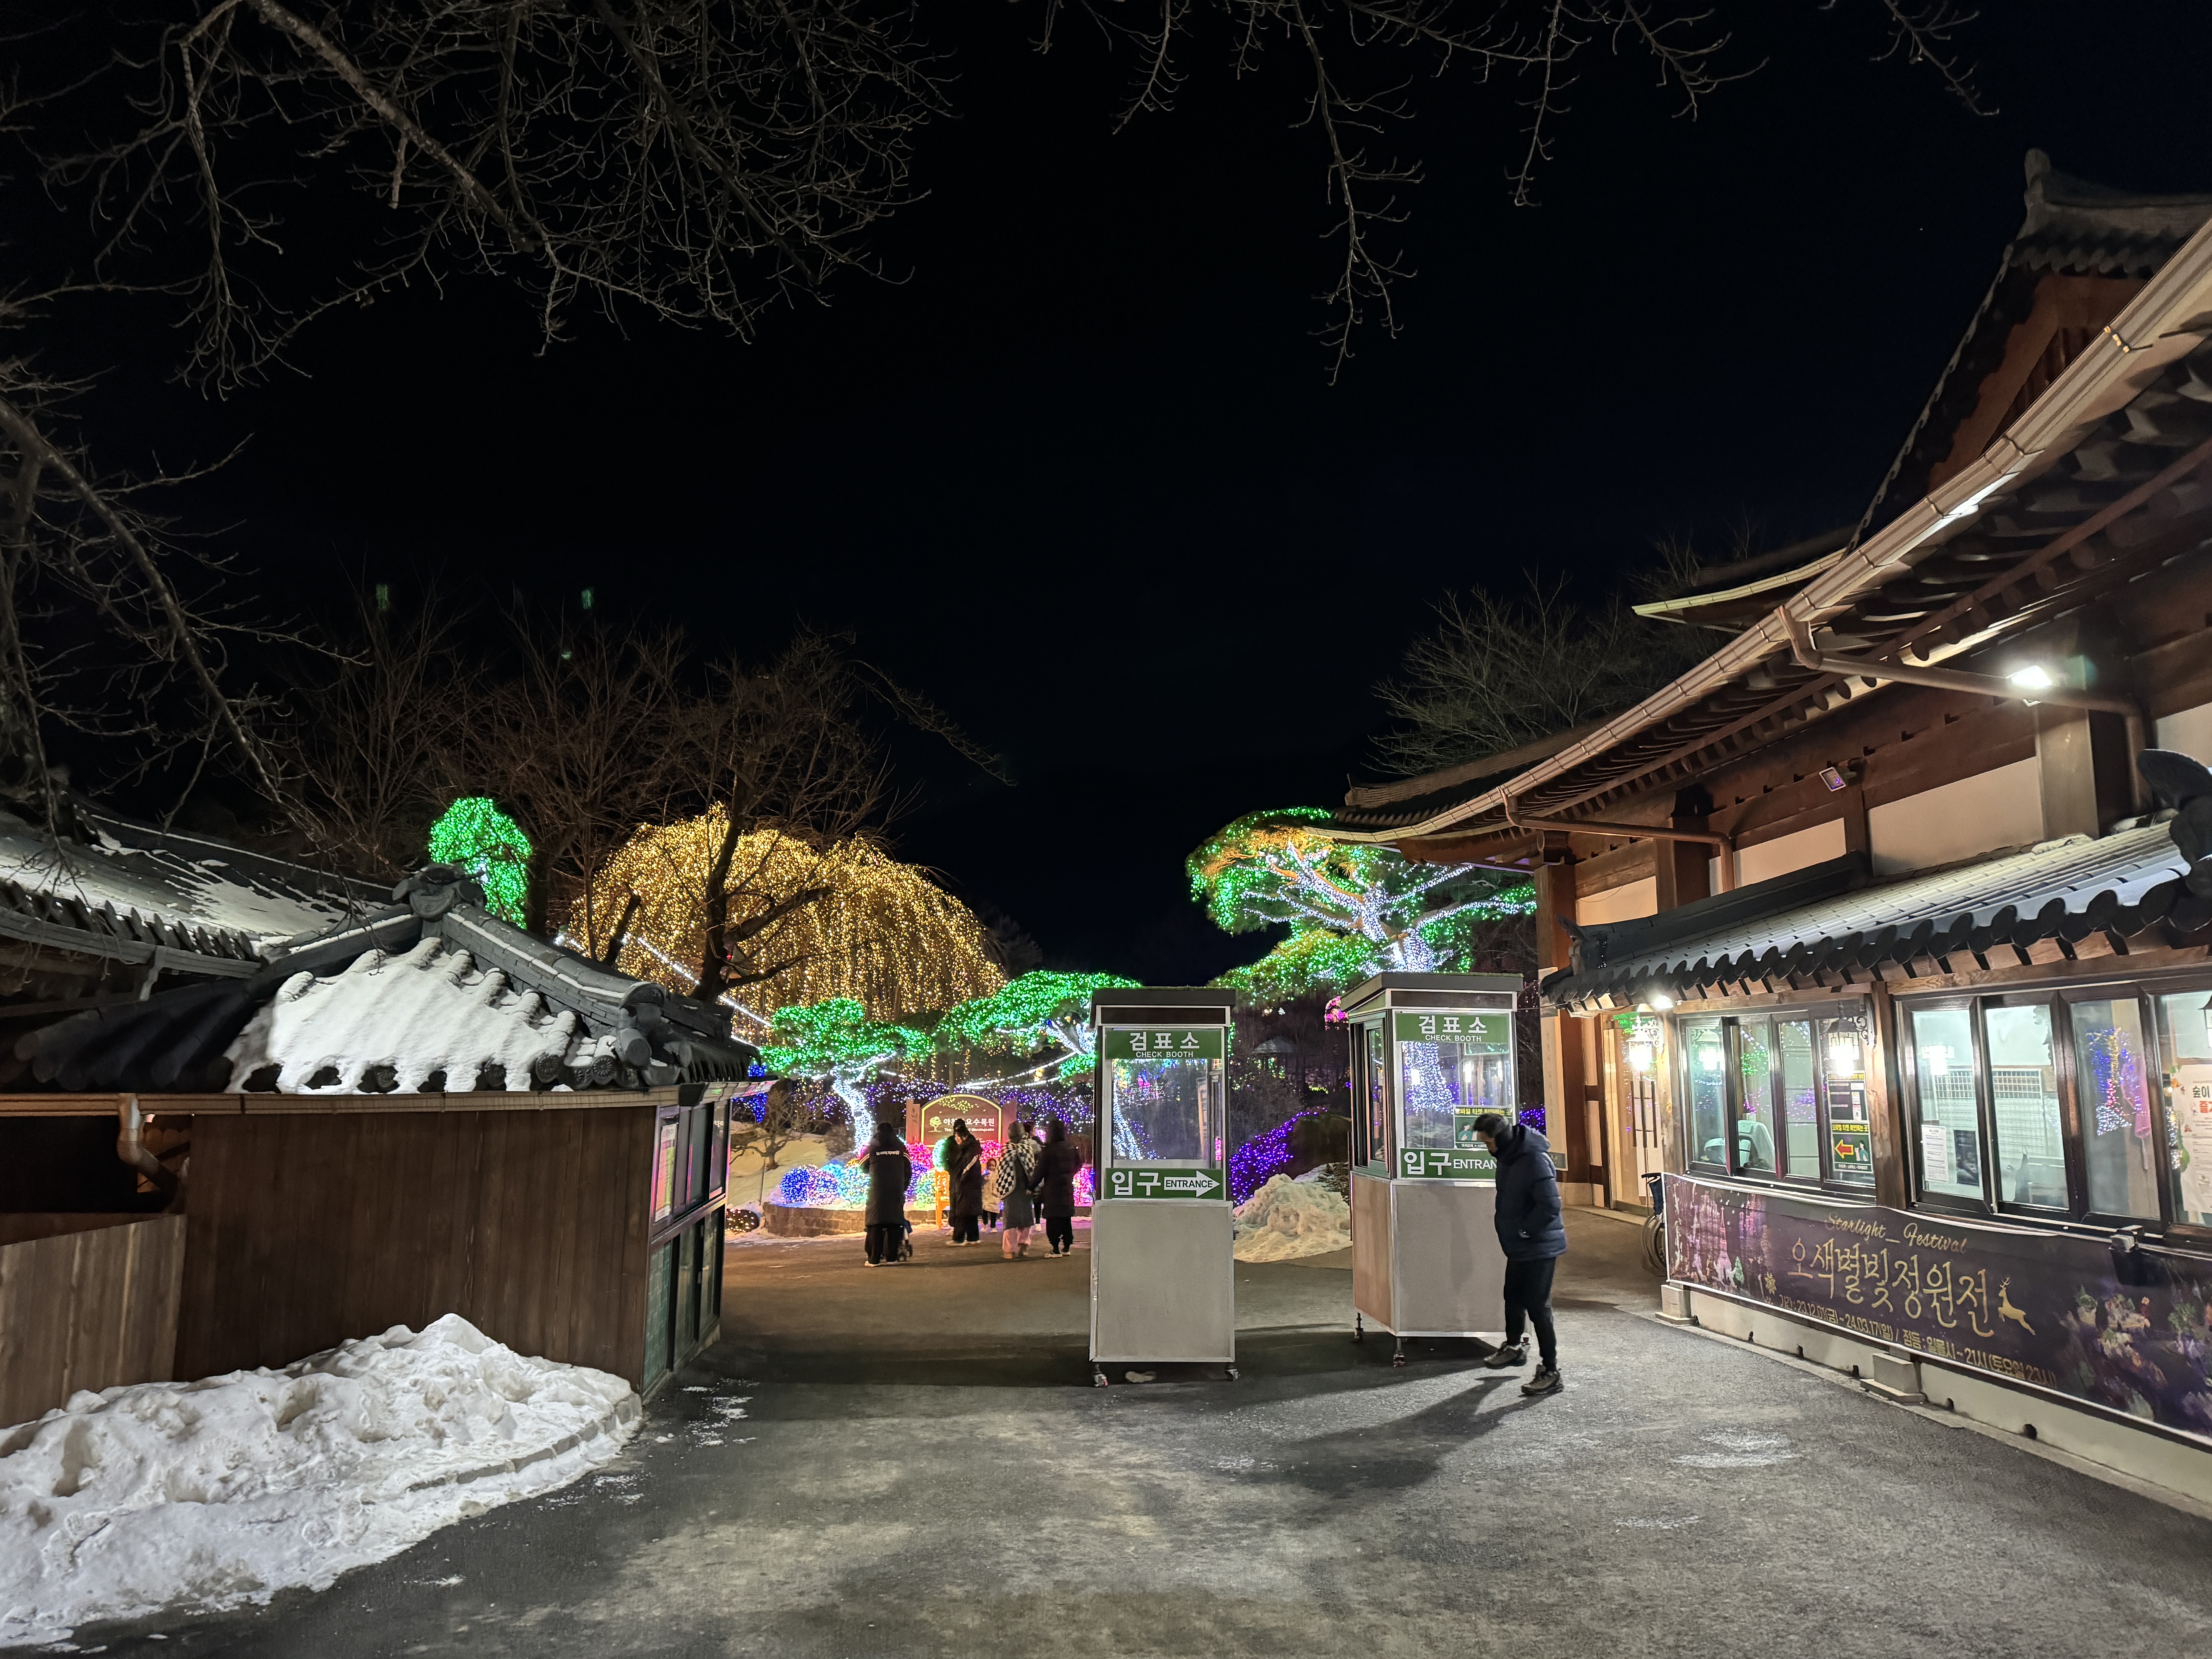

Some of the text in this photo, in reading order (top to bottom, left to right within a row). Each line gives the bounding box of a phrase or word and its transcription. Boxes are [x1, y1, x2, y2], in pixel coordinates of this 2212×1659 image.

[1419, 1015, 1487, 1034] 검표소
[1130, 1032, 1200, 1051] 검표소
[943, 1118, 994, 1127] 아요수목원
[1404, 1151, 1451, 1175] 입구
[1453, 1159, 1497, 1169] ENTRAN
[1111, 1171, 1161, 1196] 입구
[1166, 1180, 1213, 1188] ENTRANCE
[1903, 1223, 1967, 1254] Festival
